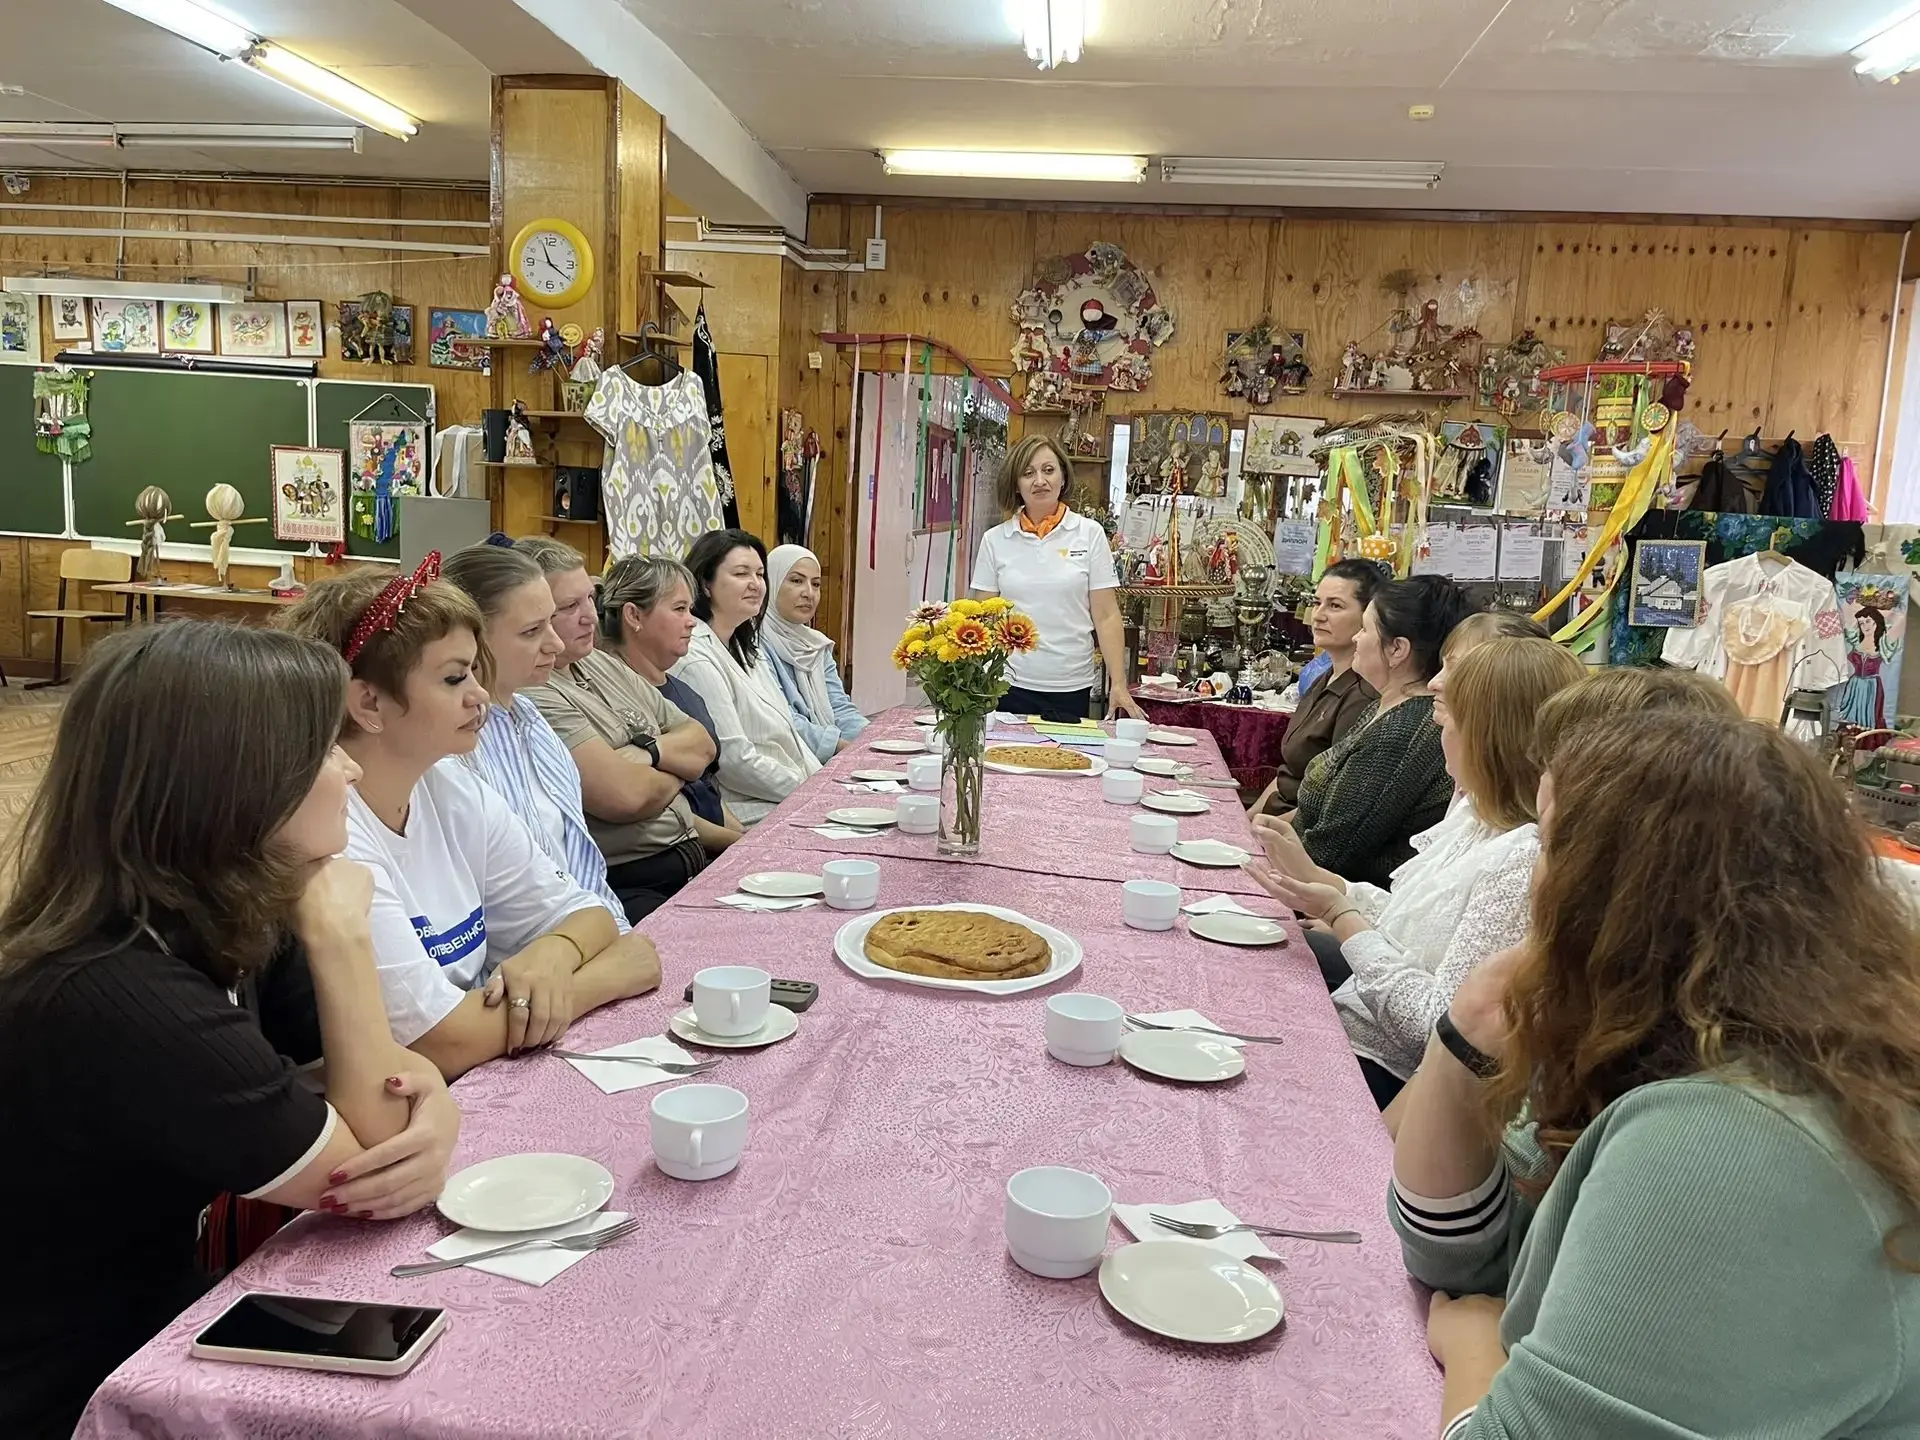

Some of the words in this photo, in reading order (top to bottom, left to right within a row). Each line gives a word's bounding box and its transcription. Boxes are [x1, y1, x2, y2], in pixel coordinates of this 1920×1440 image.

[544, 237, 556, 246] 12
[526, 257, 535, 266] 9
[566, 260, 574, 269] 3
[546, 280, 554, 289] 6
